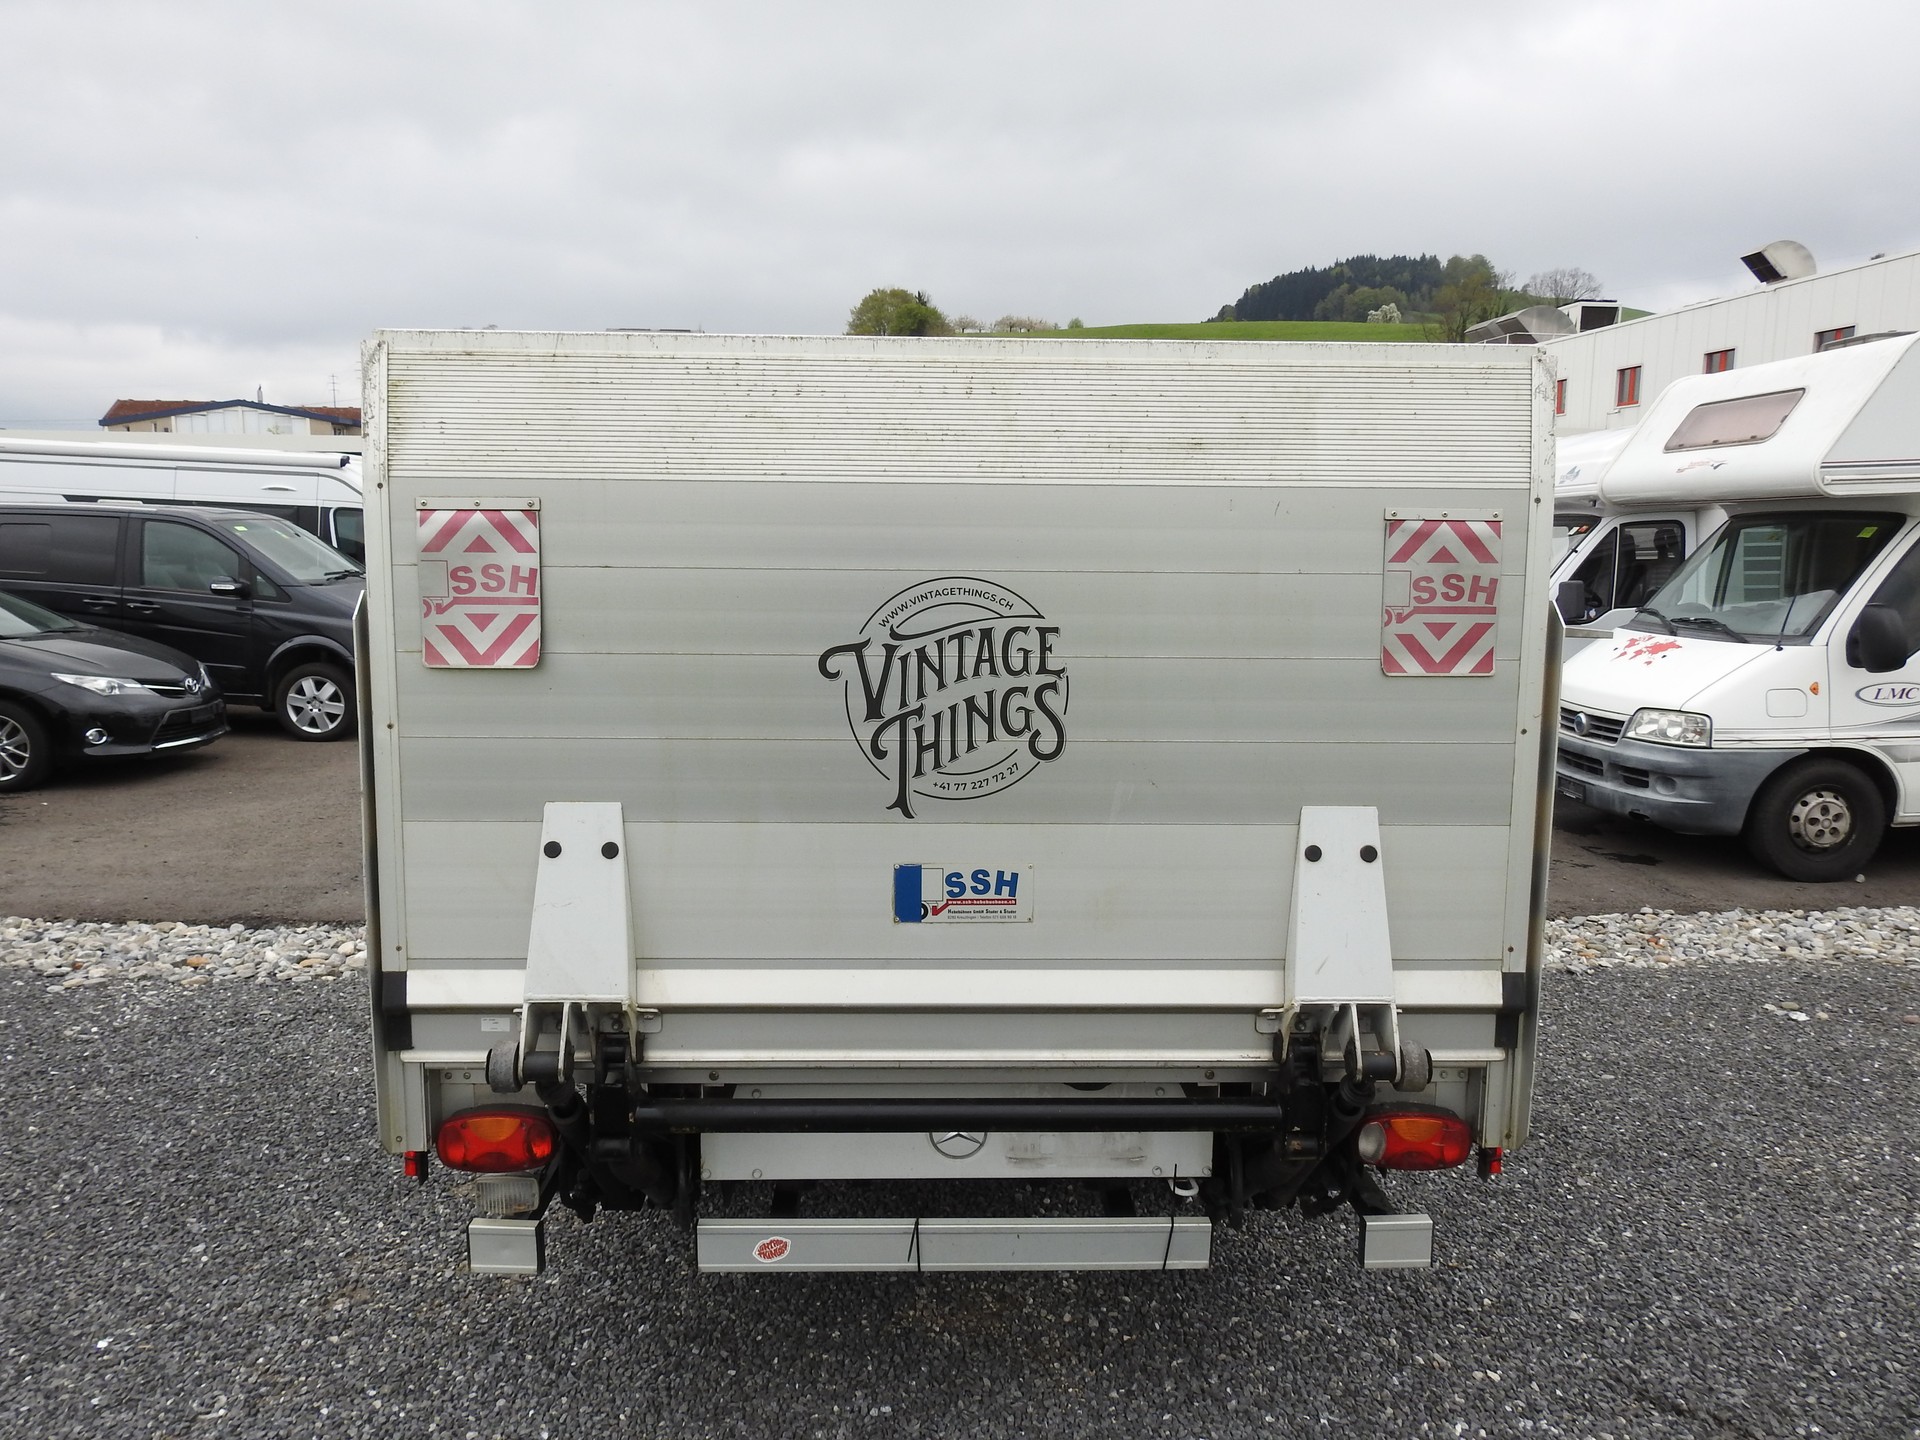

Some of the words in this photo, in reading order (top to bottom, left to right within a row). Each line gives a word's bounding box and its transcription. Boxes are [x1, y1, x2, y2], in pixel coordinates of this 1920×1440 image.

[450, 563, 538, 596] SSH
[1412, 573, 1499, 606] SSH
[878, 587, 1014, 628] WWW.VINTAGETHINGS.CH
[818, 626, 1067, 722] VINTAGE
[1872, 687, 1920, 700] LMC
[870, 680, 1067, 819] THINGS
[933, 782, 950, 791] +41
[954, 783, 967, 791] 77
[970, 778, 989, 790] 227
[992, 772, 1006, 782] 72
[1007, 762, 1019, 775] 27
[944, 869, 1019, 898] SSH
